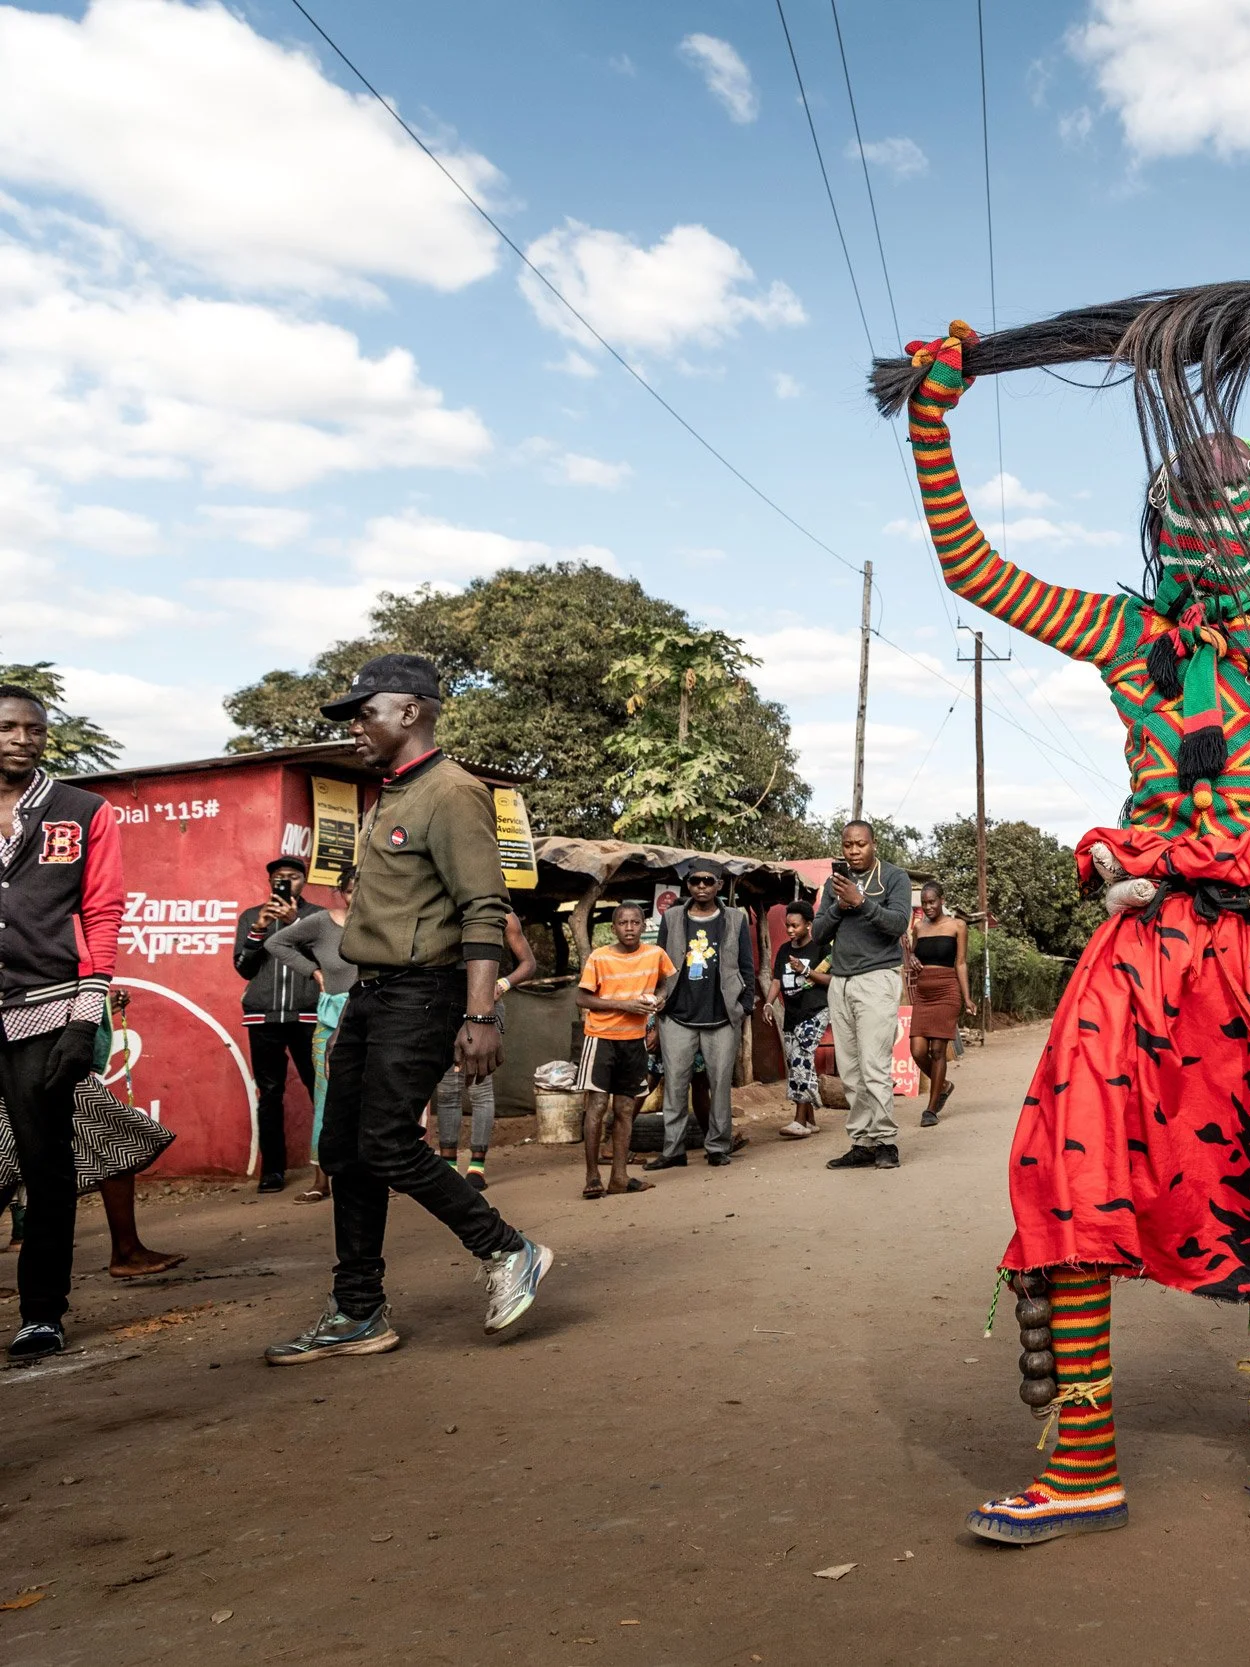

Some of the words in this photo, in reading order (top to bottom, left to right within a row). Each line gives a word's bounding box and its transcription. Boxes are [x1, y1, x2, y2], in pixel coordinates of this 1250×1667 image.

[112, 804, 150, 824] Dial
[39, 820, 82, 864] B
[121, 892, 221, 922] Zanaco
[126, 926, 220, 963] Xpress
